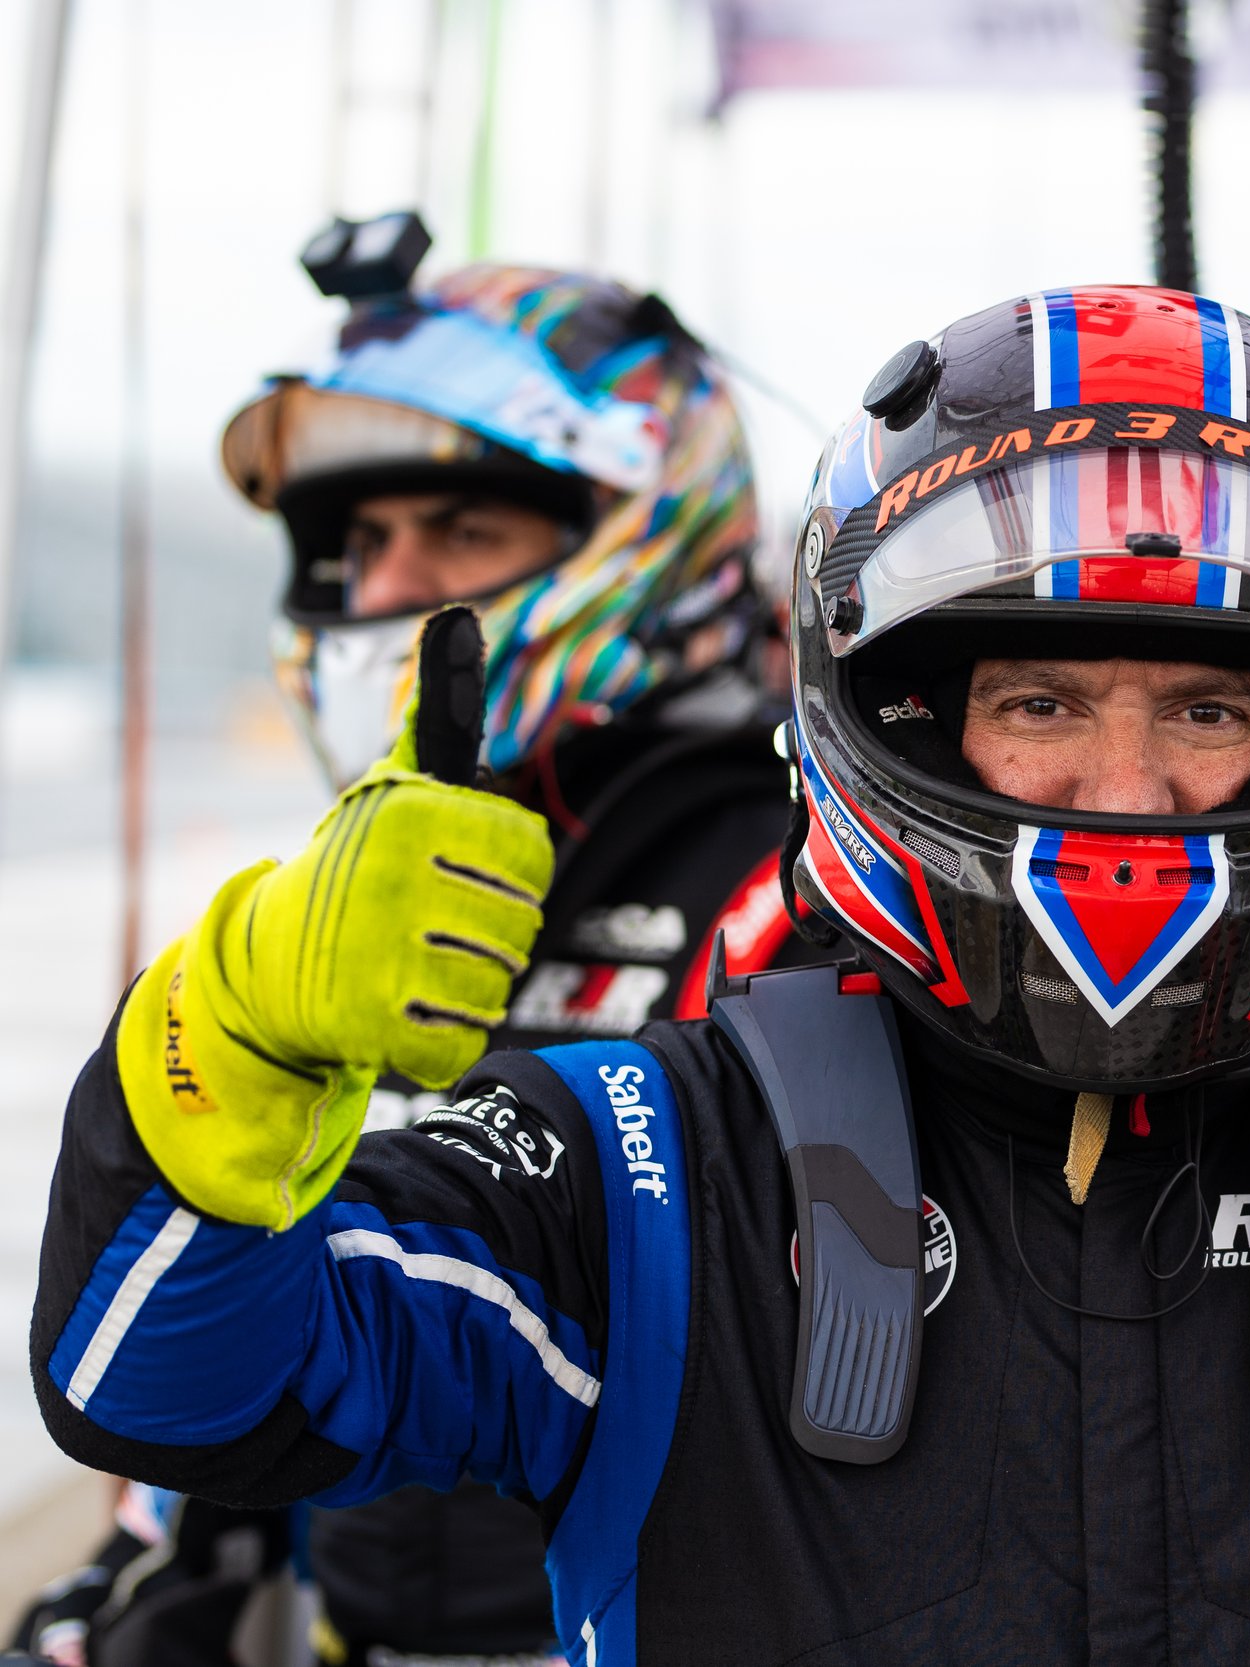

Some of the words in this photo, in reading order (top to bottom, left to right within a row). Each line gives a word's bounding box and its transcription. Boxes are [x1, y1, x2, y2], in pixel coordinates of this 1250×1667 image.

[875, 418, 1096, 534] ROUND
[1111, 411, 1177, 440] 3
[598, 1064, 668, 1205] Sabelt
